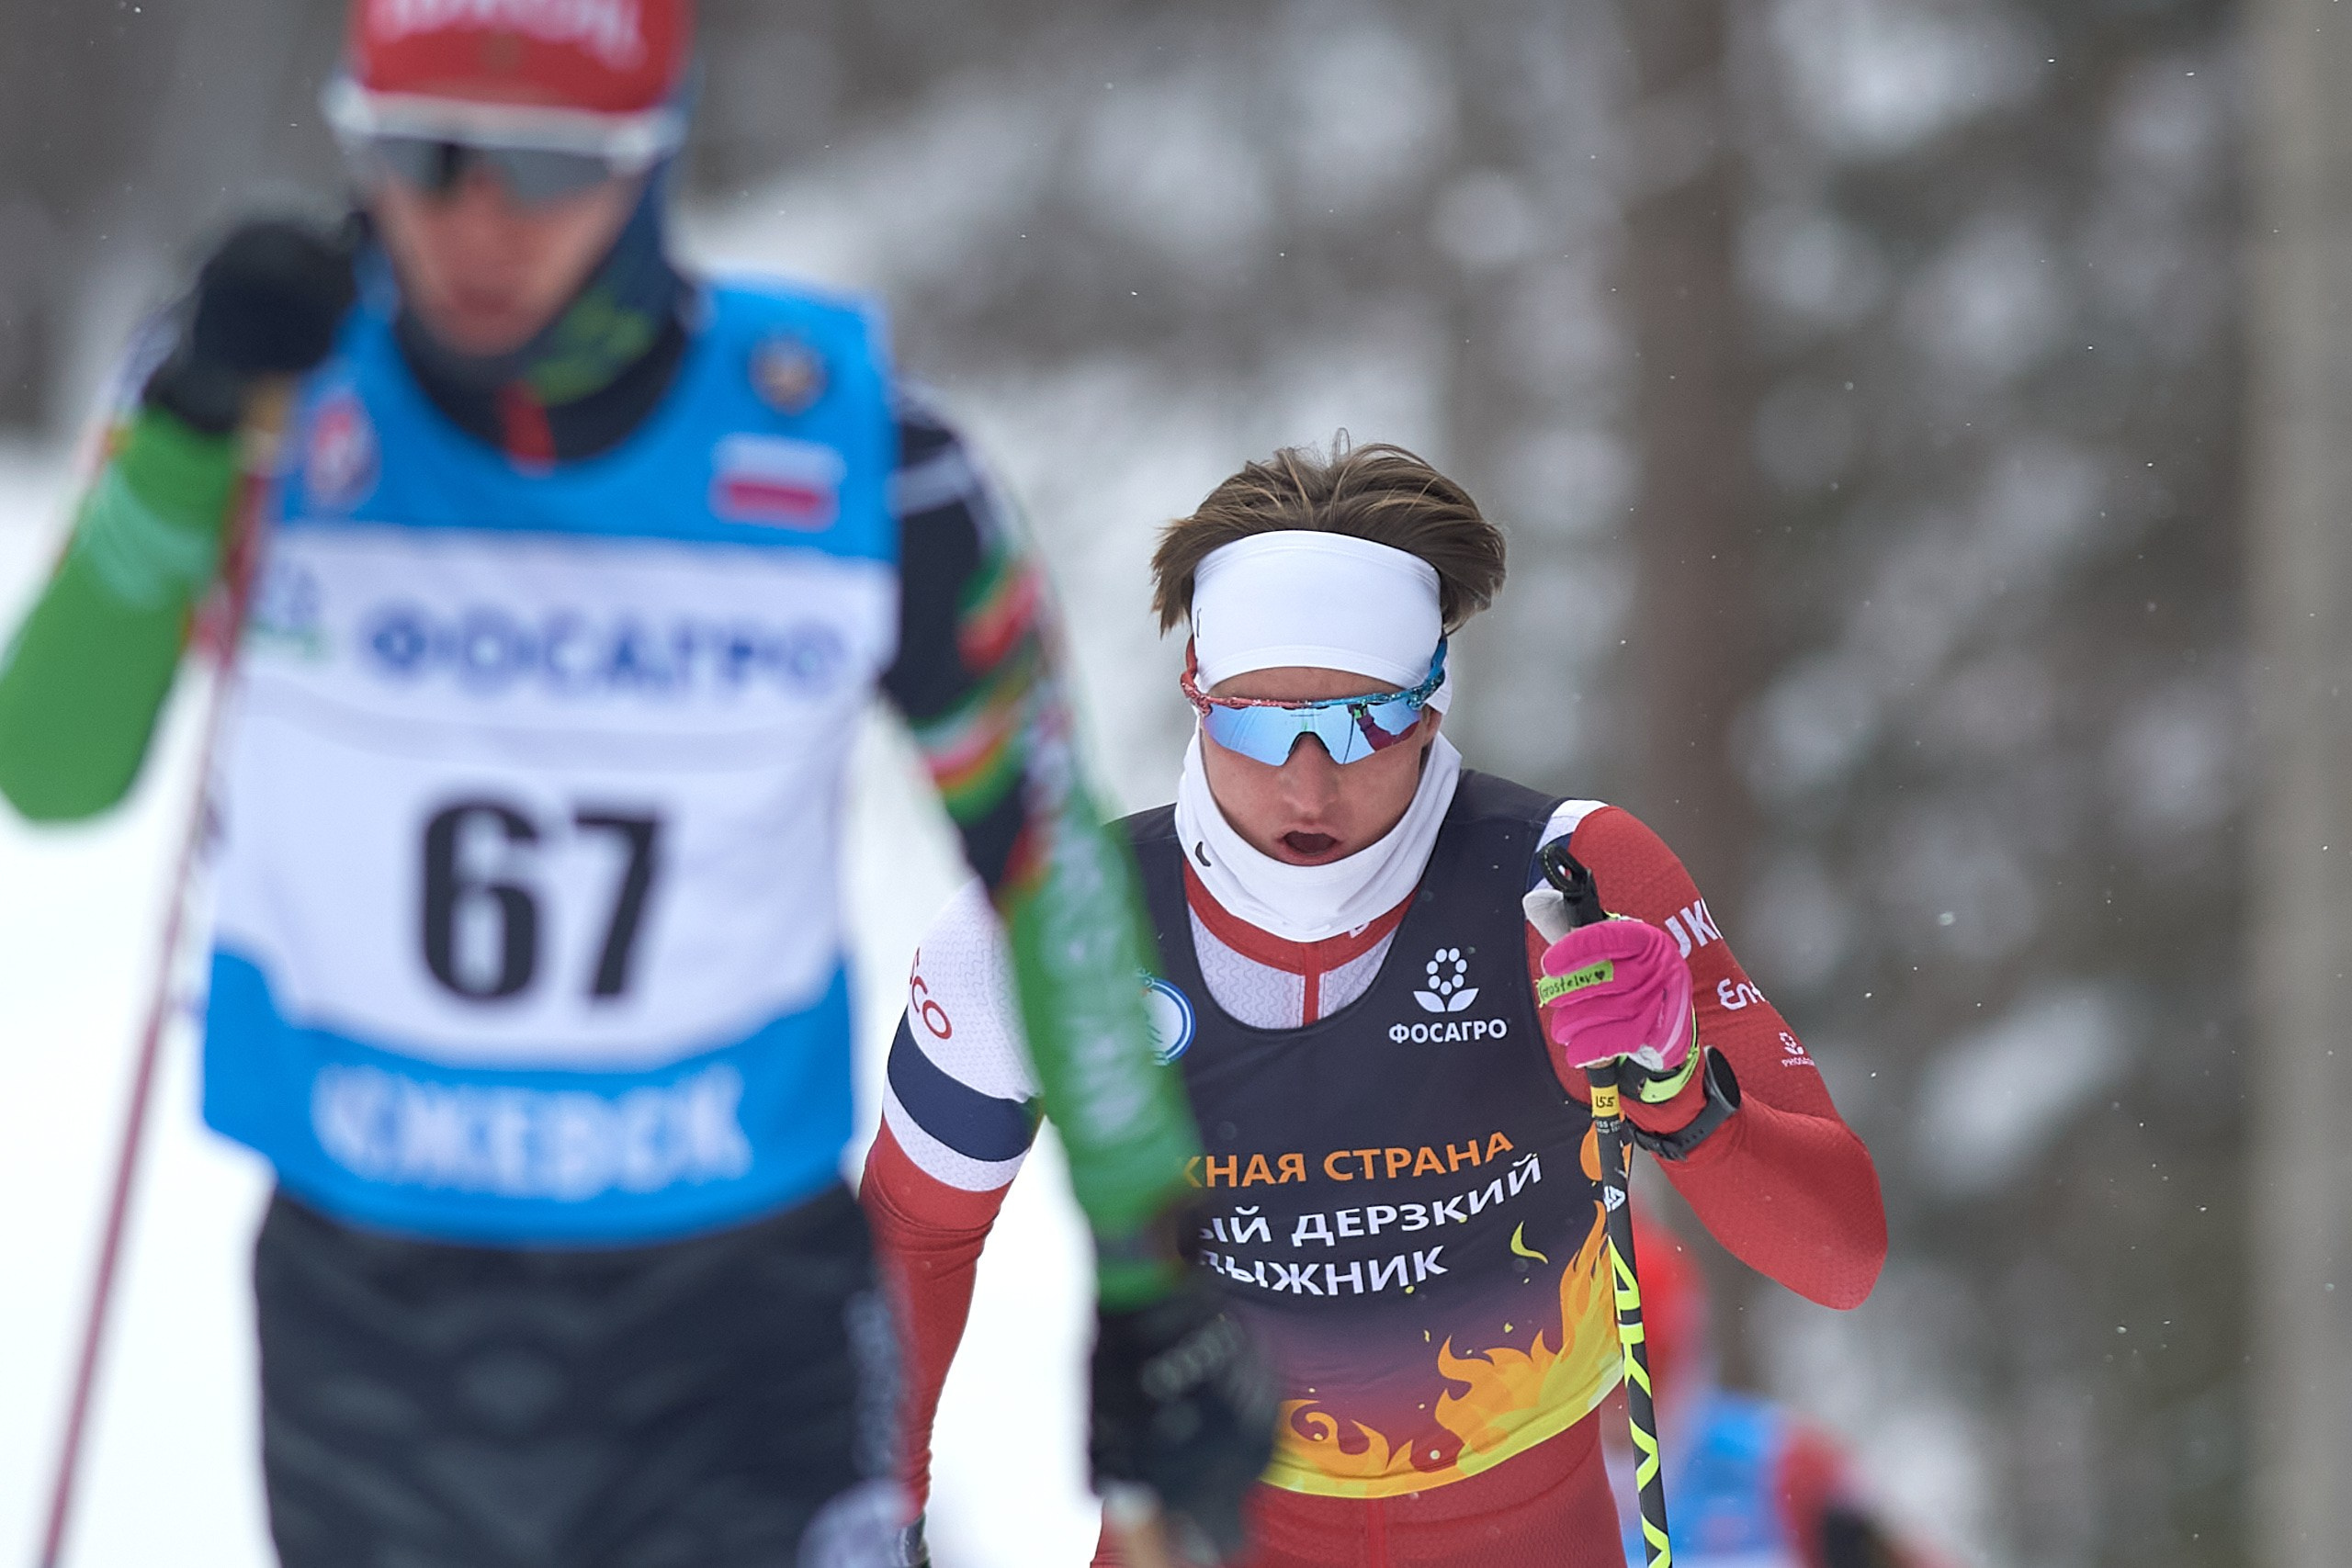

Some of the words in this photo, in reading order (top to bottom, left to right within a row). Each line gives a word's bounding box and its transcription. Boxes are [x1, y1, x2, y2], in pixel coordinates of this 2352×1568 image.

[419, 797, 660, 1001] 67
[1388, 1018, 1508, 1043] ФОСАГРО
[1323, 1132, 1515, 1181] СТРАНА
[1291, 1152, 1543, 1247] ДЕРЗКИЙ
